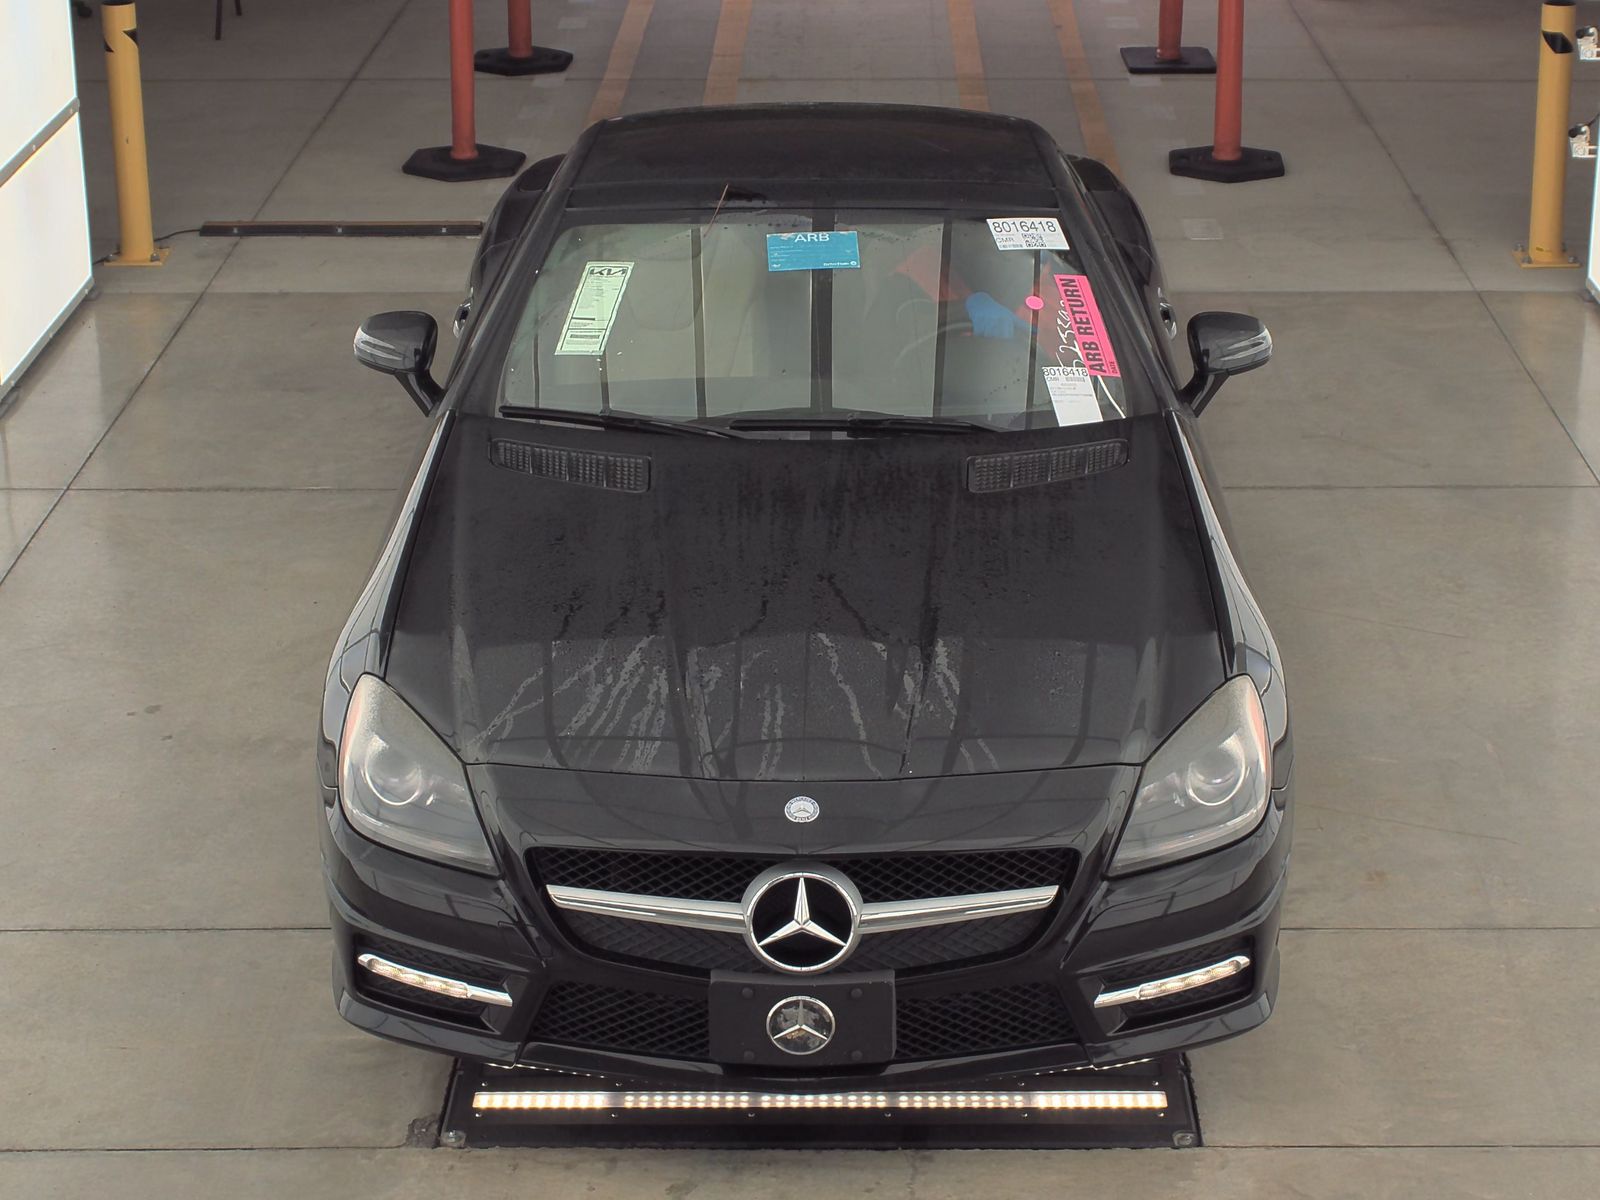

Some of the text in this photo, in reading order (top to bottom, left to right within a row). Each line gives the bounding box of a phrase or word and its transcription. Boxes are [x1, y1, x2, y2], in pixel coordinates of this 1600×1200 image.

[992, 221, 1056, 233] 8016418
[794, 233, 830, 243] ARB
[1059, 277, 1107, 374] ARB RETURN
[1042, 367, 1088, 377] 8016418
